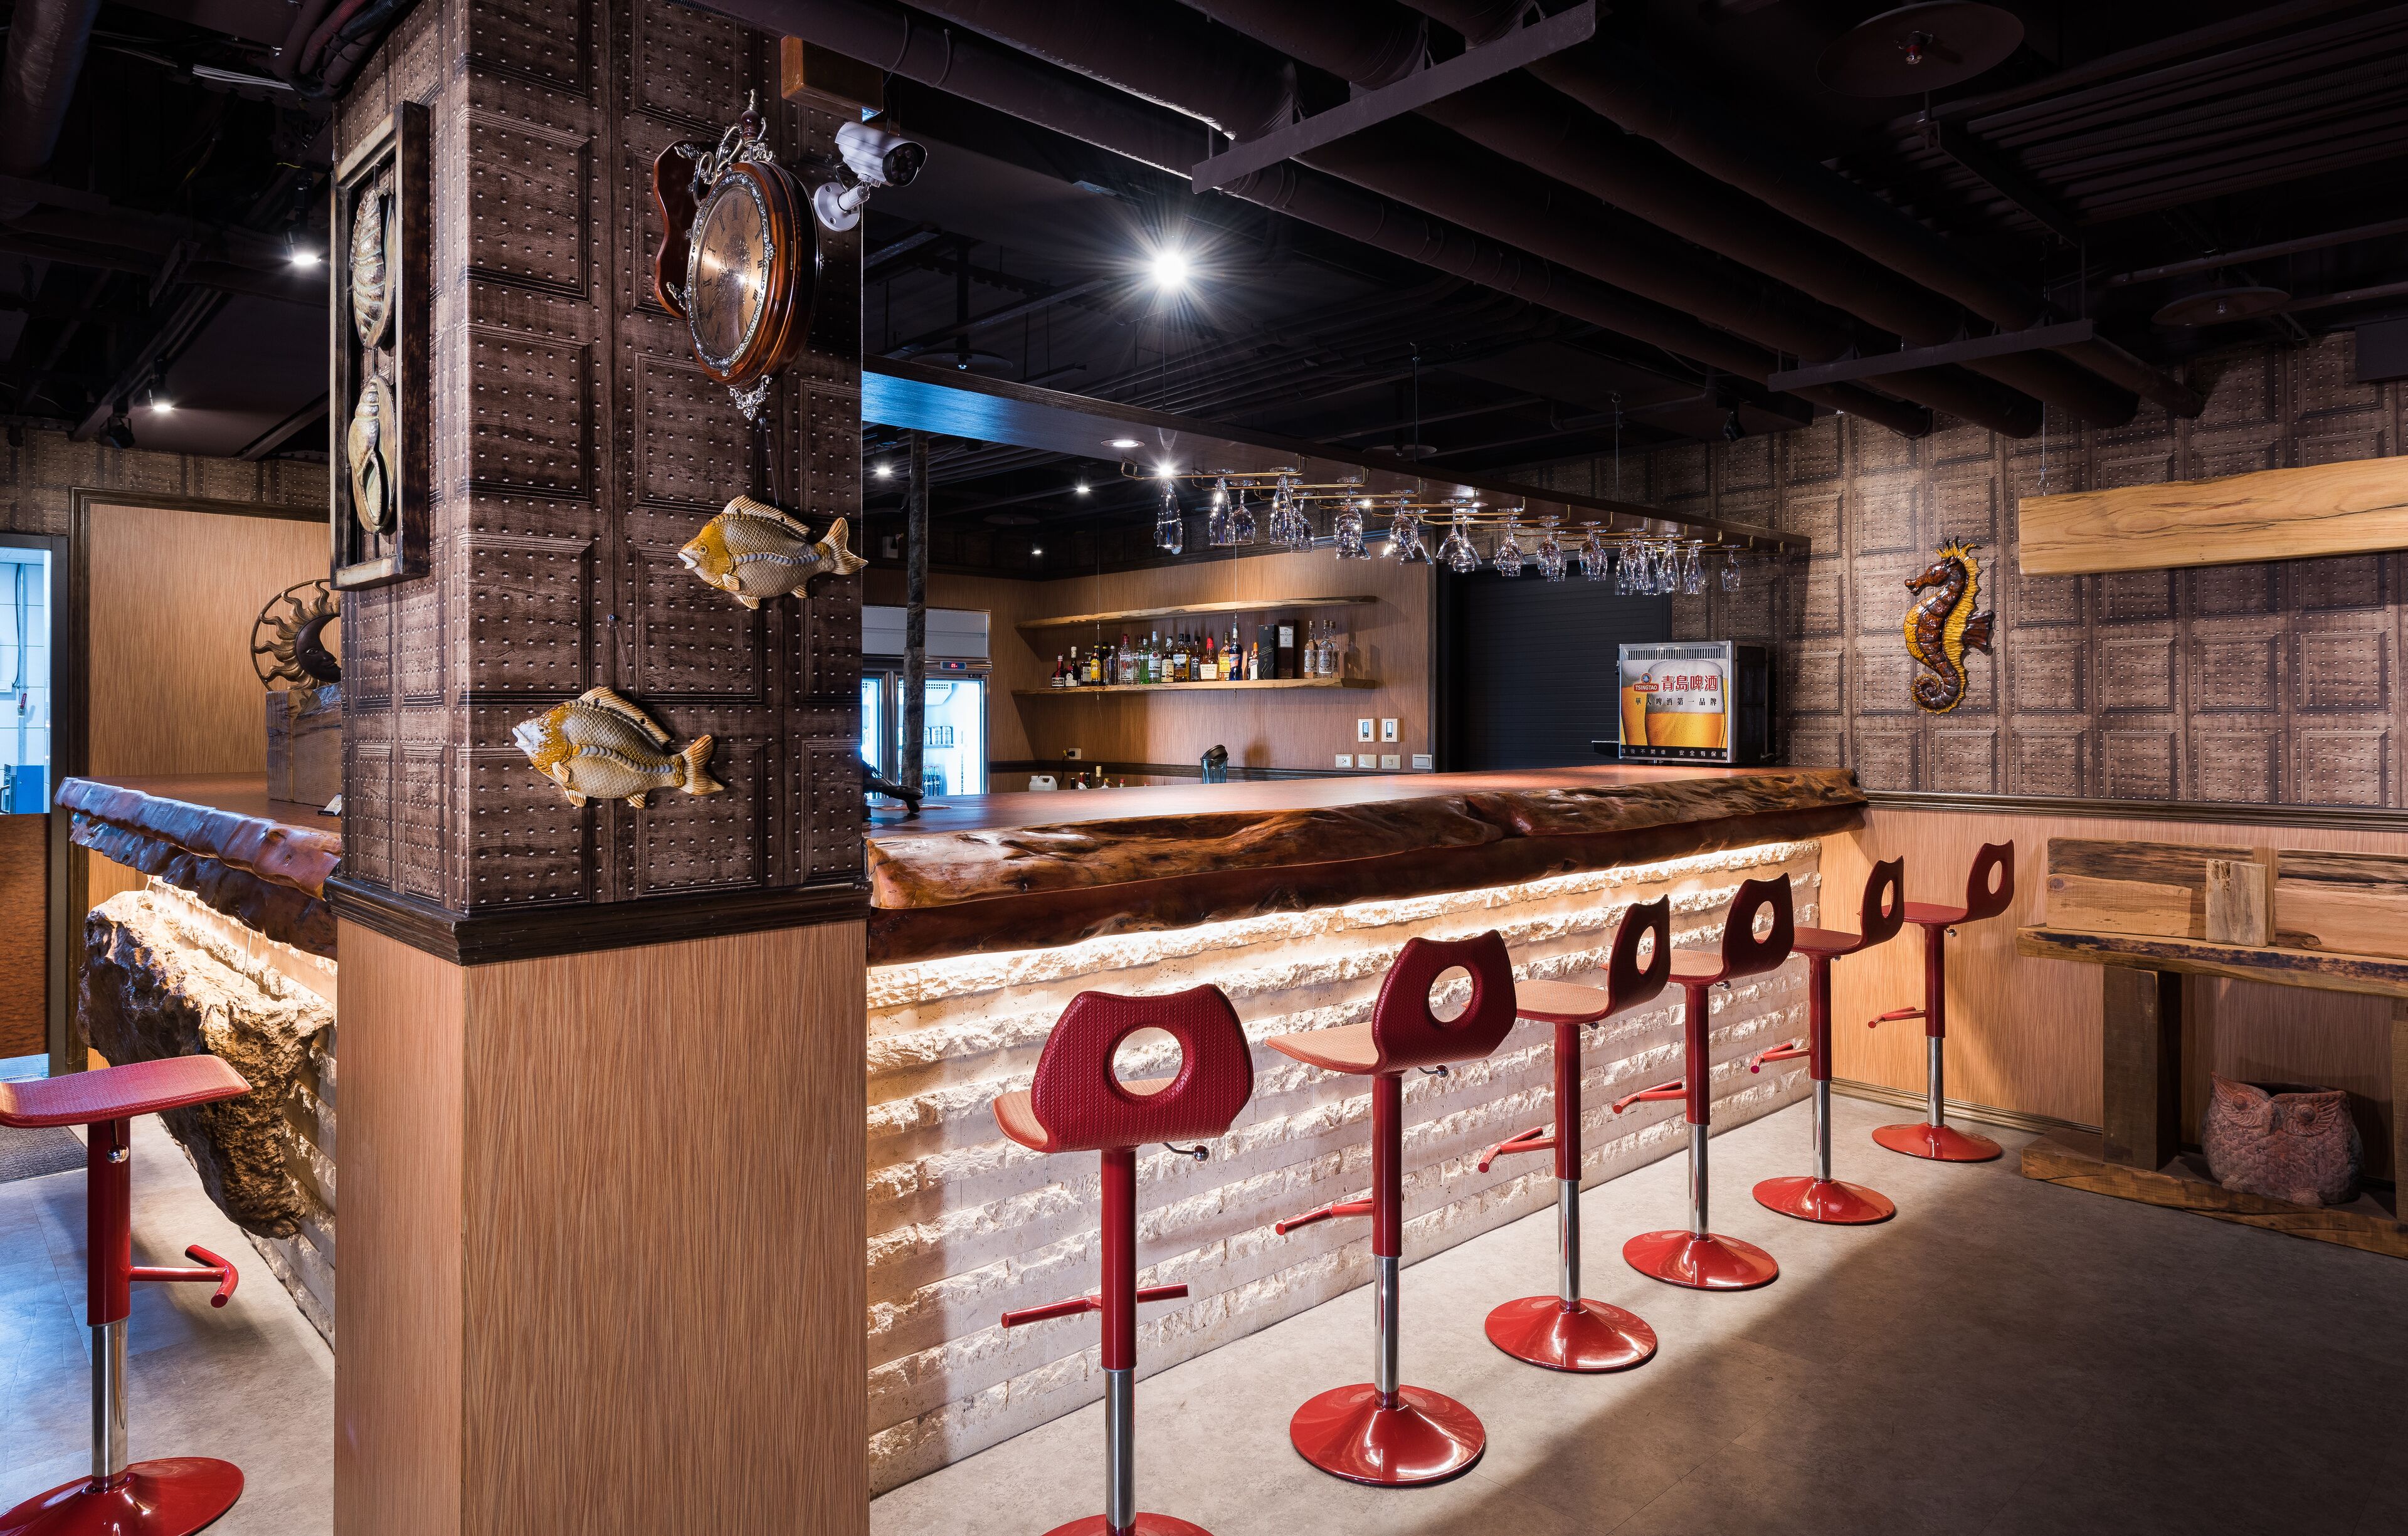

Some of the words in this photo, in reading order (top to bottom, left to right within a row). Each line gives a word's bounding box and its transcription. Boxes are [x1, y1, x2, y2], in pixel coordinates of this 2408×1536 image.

[1661, 675, 1719, 692] 青島啤酒
[1635, 697, 1717, 706] 華人啤酒第一品牌
